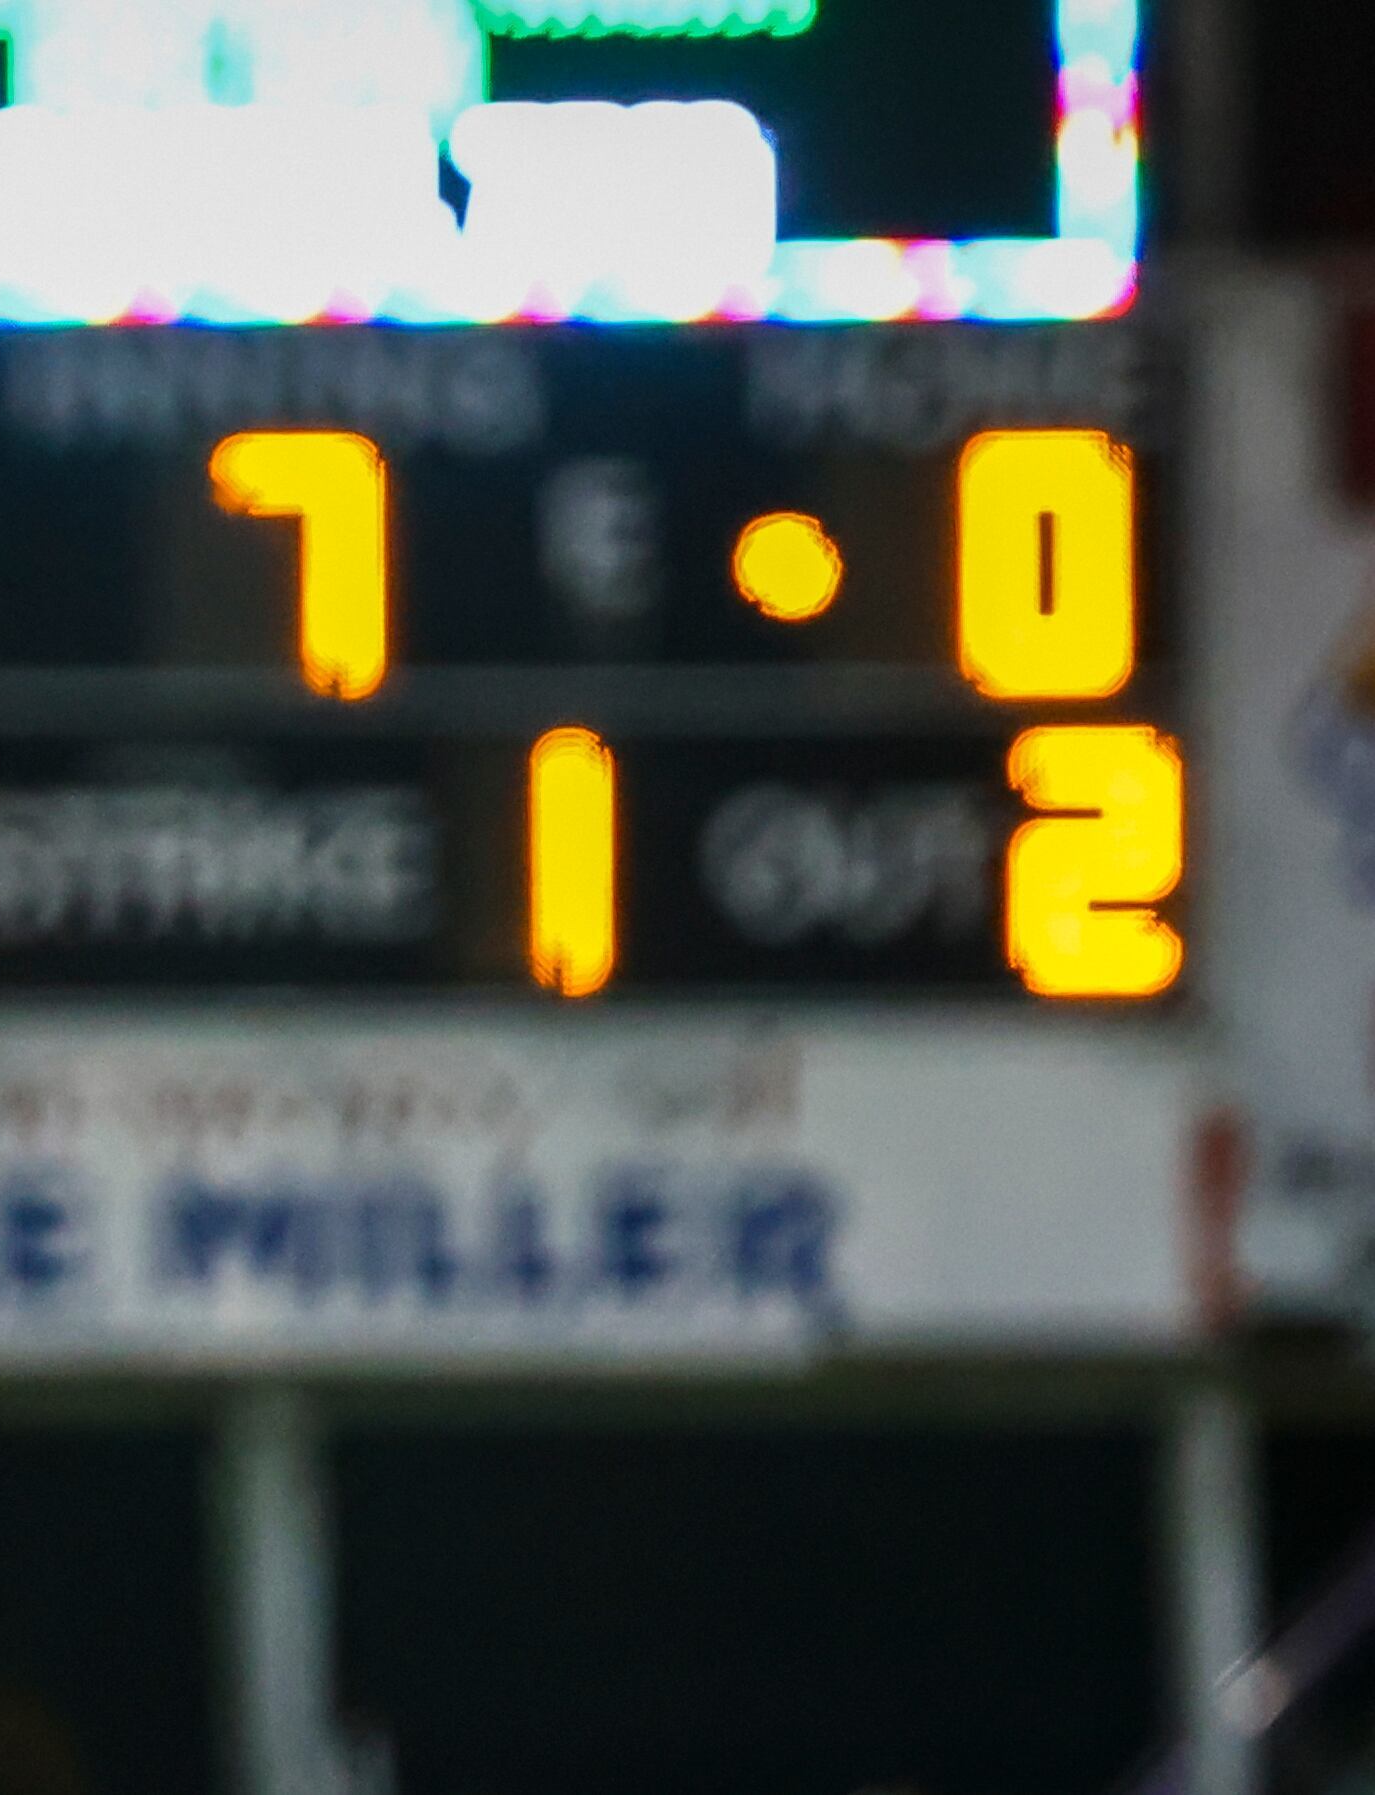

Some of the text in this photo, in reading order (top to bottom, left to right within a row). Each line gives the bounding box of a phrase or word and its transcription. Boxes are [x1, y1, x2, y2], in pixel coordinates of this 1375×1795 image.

[210, 431, 387, 702] 7
[956, 430, 1135, 701] 0
[529, 726, 616, 997] 1
[701, 782, 990, 942] OUT
[1005, 725, 1184, 998] 2
[154, 1162, 846, 1303] MILLER
